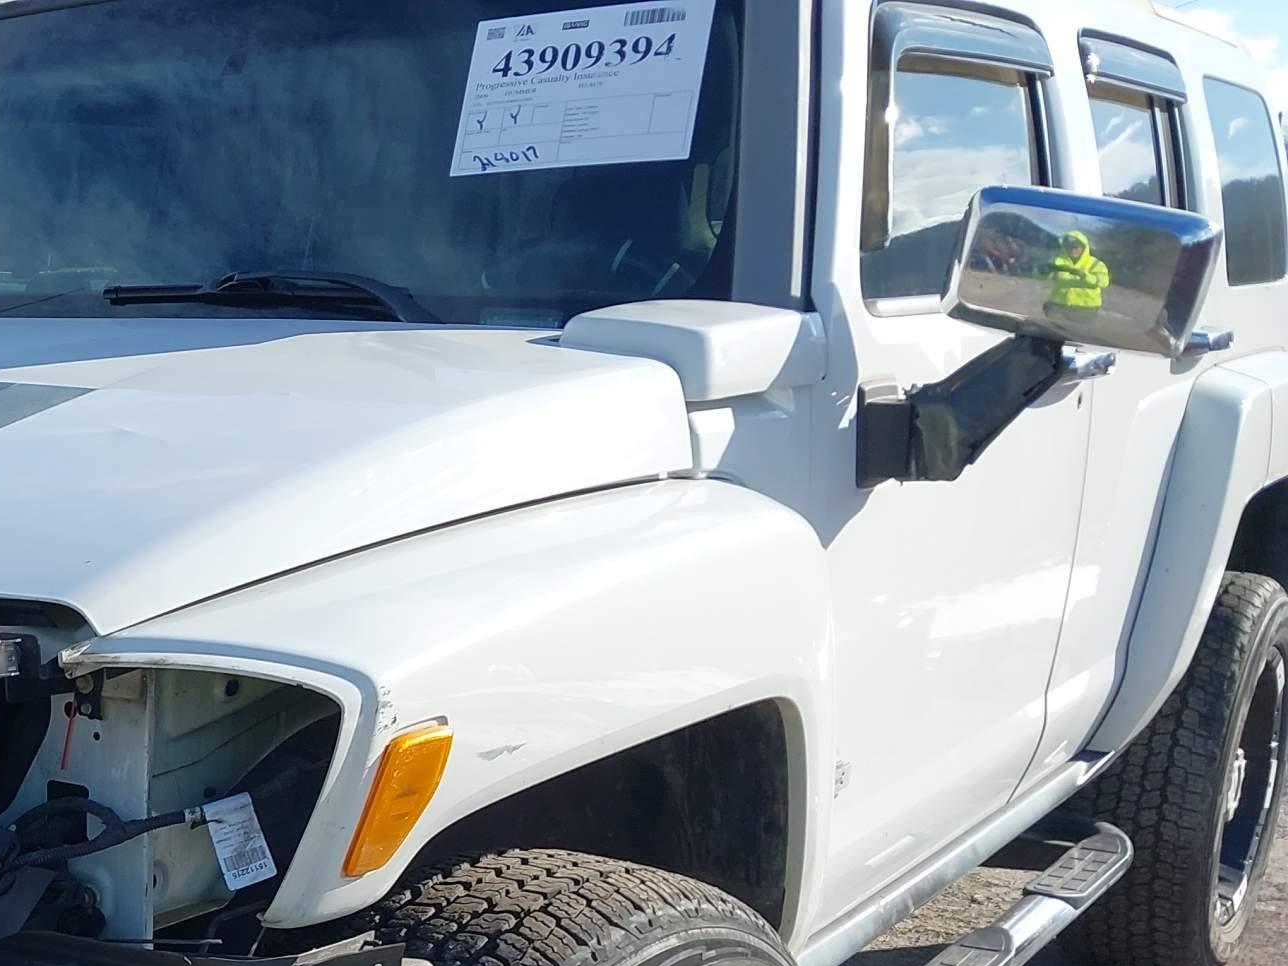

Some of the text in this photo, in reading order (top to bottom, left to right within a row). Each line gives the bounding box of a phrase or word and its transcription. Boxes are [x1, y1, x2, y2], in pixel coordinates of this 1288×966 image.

[492, 33, 677, 78] 43909394
[476, 79, 529, 91] Progressive
[531, 75, 570, 87] Casualty
[574, 70, 620, 81] Insurce
